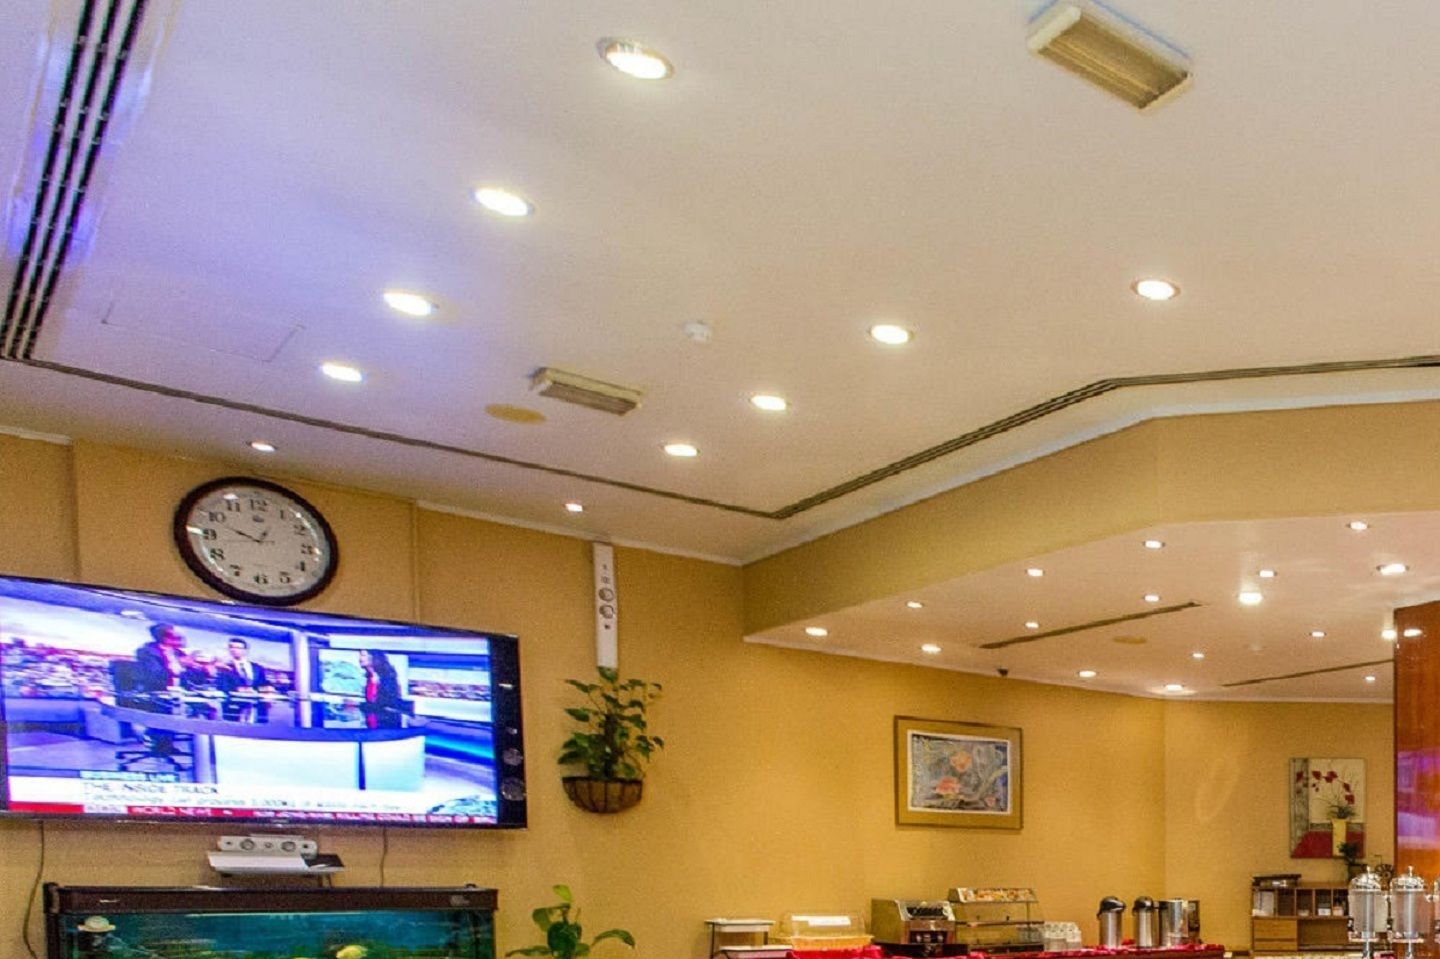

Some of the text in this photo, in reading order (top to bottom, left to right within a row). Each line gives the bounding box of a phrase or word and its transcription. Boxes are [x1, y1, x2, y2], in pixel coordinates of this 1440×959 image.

[225, 500, 240, 512] 11
[249, 499, 267, 512] 12
[209, 511, 226, 523] 10
[203, 528, 217, 540] 9
[294, 524, 306, 536] 2
[210, 548, 225, 560] 8
[301, 543, 313, 555] 3
[279, 571, 290, 584] 5
